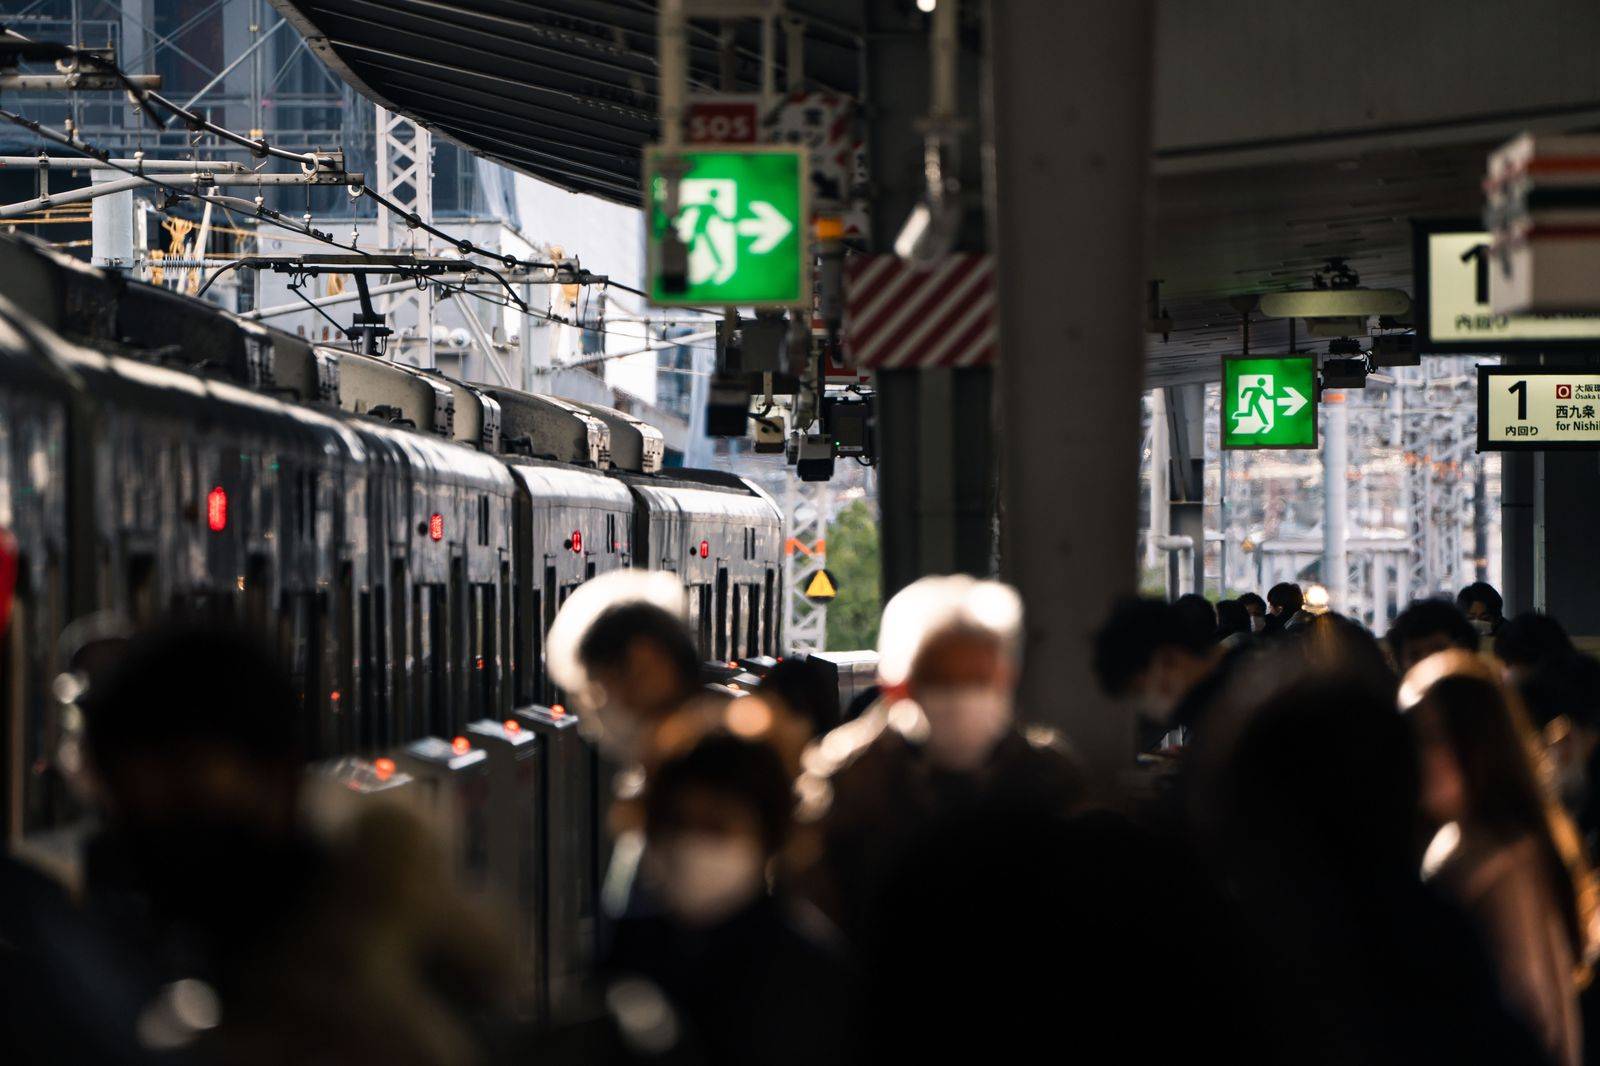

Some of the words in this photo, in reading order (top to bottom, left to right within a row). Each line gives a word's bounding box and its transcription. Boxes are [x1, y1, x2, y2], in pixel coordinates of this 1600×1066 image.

[690, 115, 750, 141] SOS
[1460, 243, 1489, 304] 1
[1508, 380, 1527, 420] 1
[1556, 405, 1595, 418] 西九条
[1505, 425, 1539, 436] 内回り
[1556, 421, 1570, 431] for
